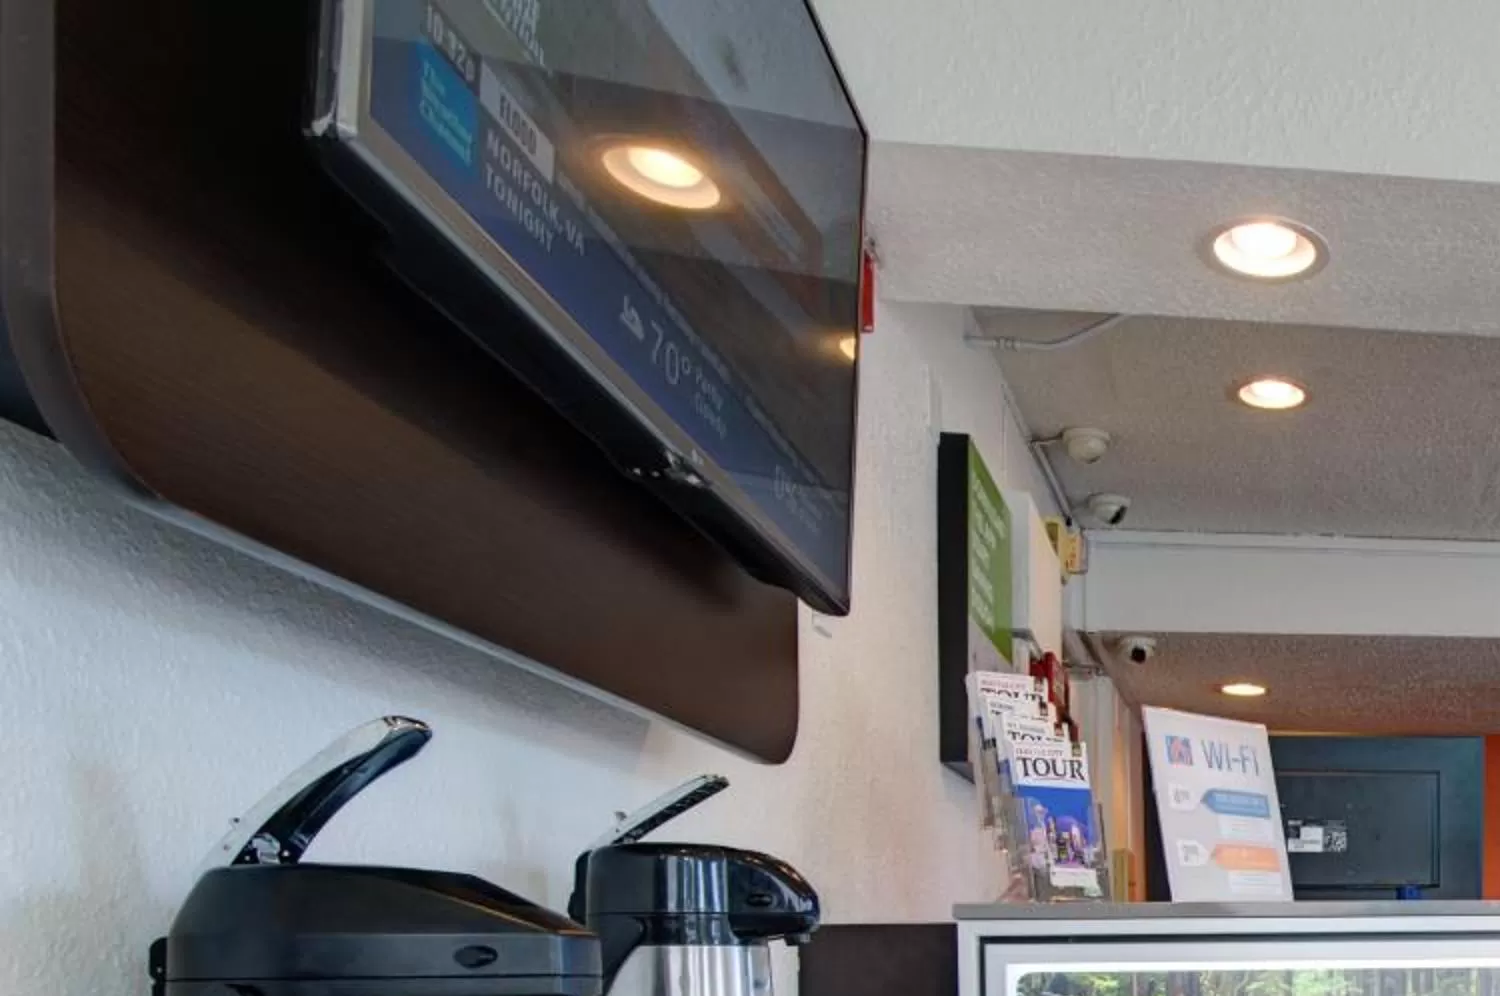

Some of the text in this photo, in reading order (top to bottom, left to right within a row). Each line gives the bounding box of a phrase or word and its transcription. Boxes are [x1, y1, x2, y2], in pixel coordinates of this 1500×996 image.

[485, 163, 553, 252] TONIGHT
[1016, 756, 1086, 781] TOUR
[1201, 738, 1260, 777] WI-FI
